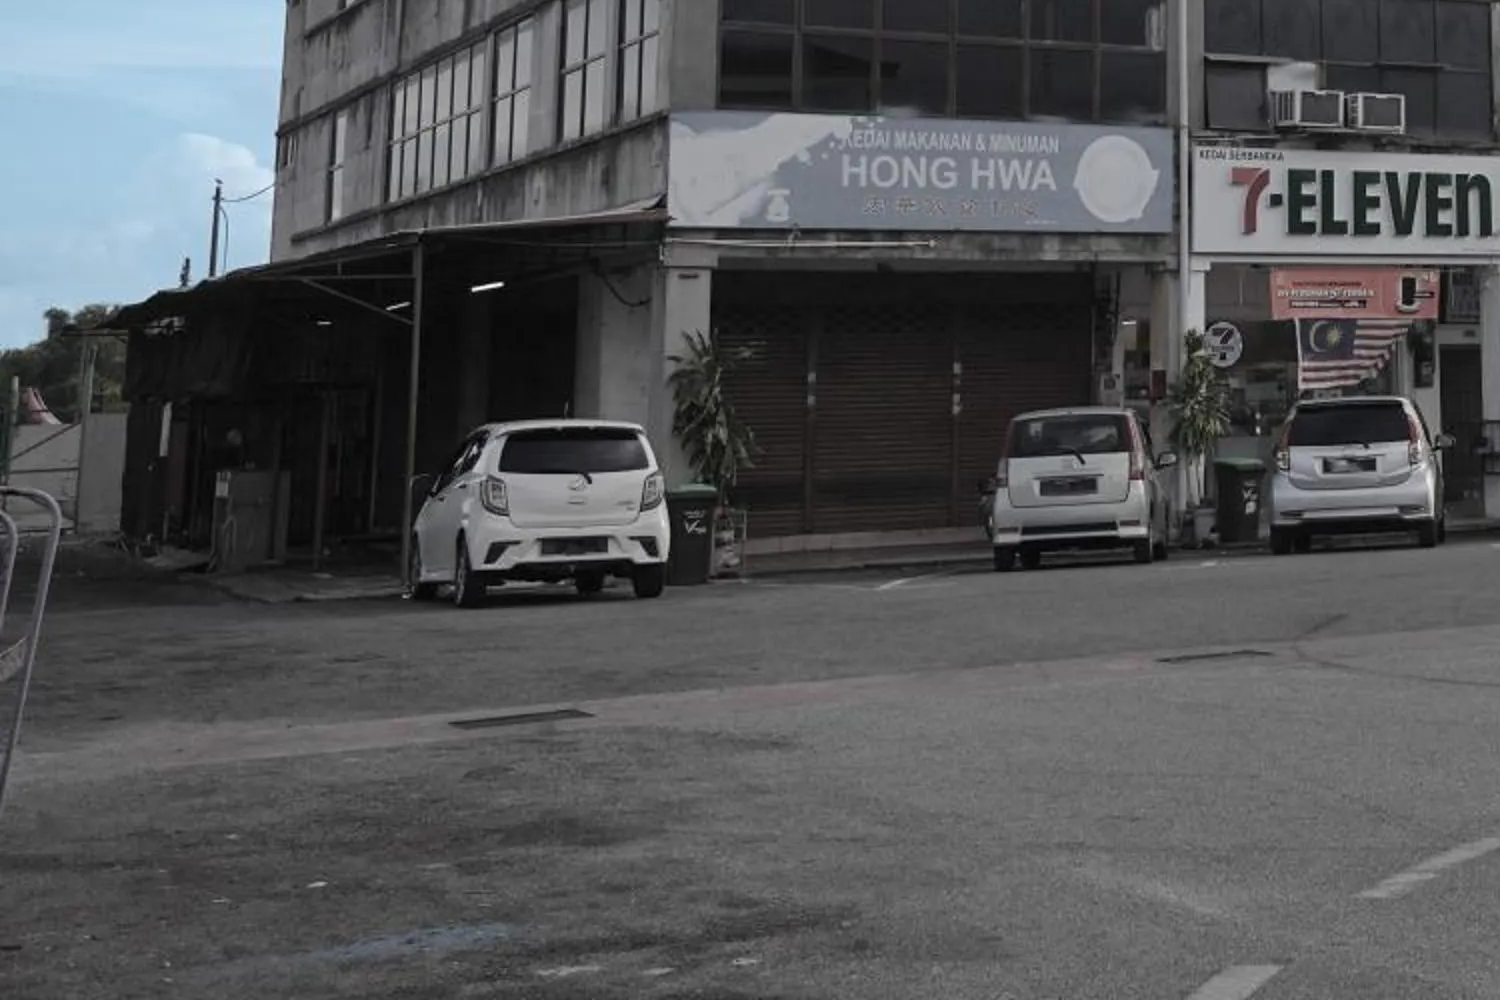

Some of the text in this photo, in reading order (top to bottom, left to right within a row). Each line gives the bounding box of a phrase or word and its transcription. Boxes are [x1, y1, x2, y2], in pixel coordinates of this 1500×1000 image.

[842, 129, 890, 149] KEDAI
[894, 131, 972, 151] MAKANAN
[841, 153, 1058, 191] HONG HWA
